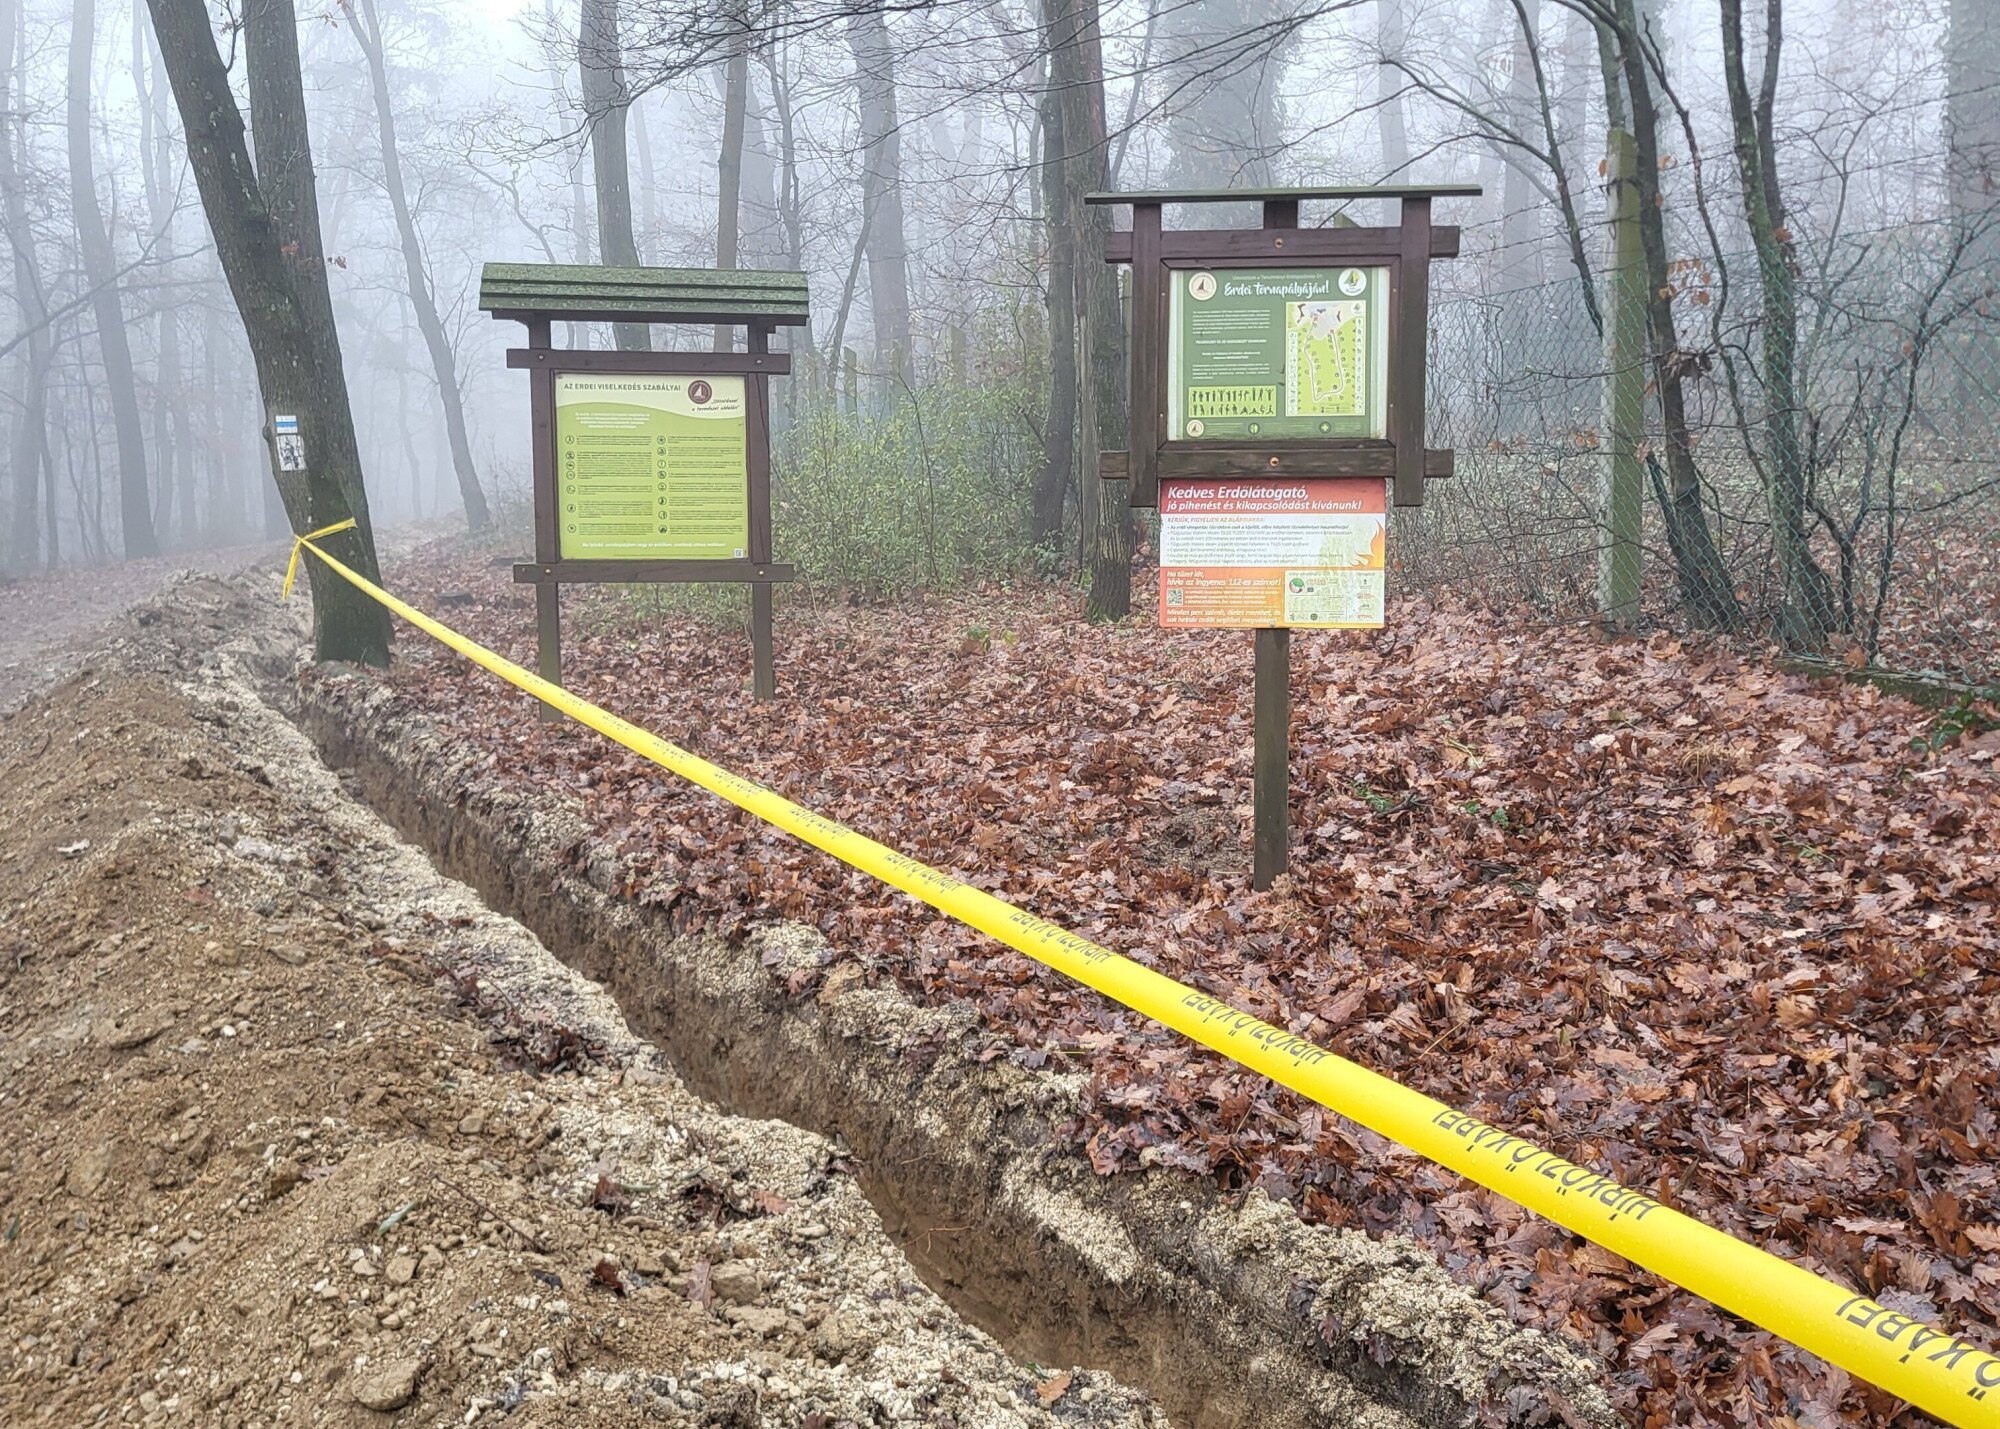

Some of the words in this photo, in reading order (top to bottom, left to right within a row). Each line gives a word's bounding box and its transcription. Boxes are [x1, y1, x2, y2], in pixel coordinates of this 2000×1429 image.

[1224, 282, 1252, 296] Erdei
[597, 382, 642, 391] VISELKEDÉS
[642, 382, 681, 392] SZABÁLYAI
[1168, 486, 1214, 499] Kedves
[1217, 485, 1309, 501] Erdőlátogató,
[1166, 500, 1178, 512] jó
[1178, 500, 1222, 512] pihenést
[1223, 500, 1234, 510] és
[1236, 500, 1310, 512] kikapcsolódást
[1311, 499, 1362, 511] kívánunk!
[1195, 579, 1226, 587] ingyenes
[1181, 992, 1240, 1023] KÁBEL
[1432, 1109, 1520, 1154] KÁBEL
[1505, 1146, 1661, 1222] HÍRKÖZLŐ
[1835, 1297, 1980, 1370] KÁBEL
